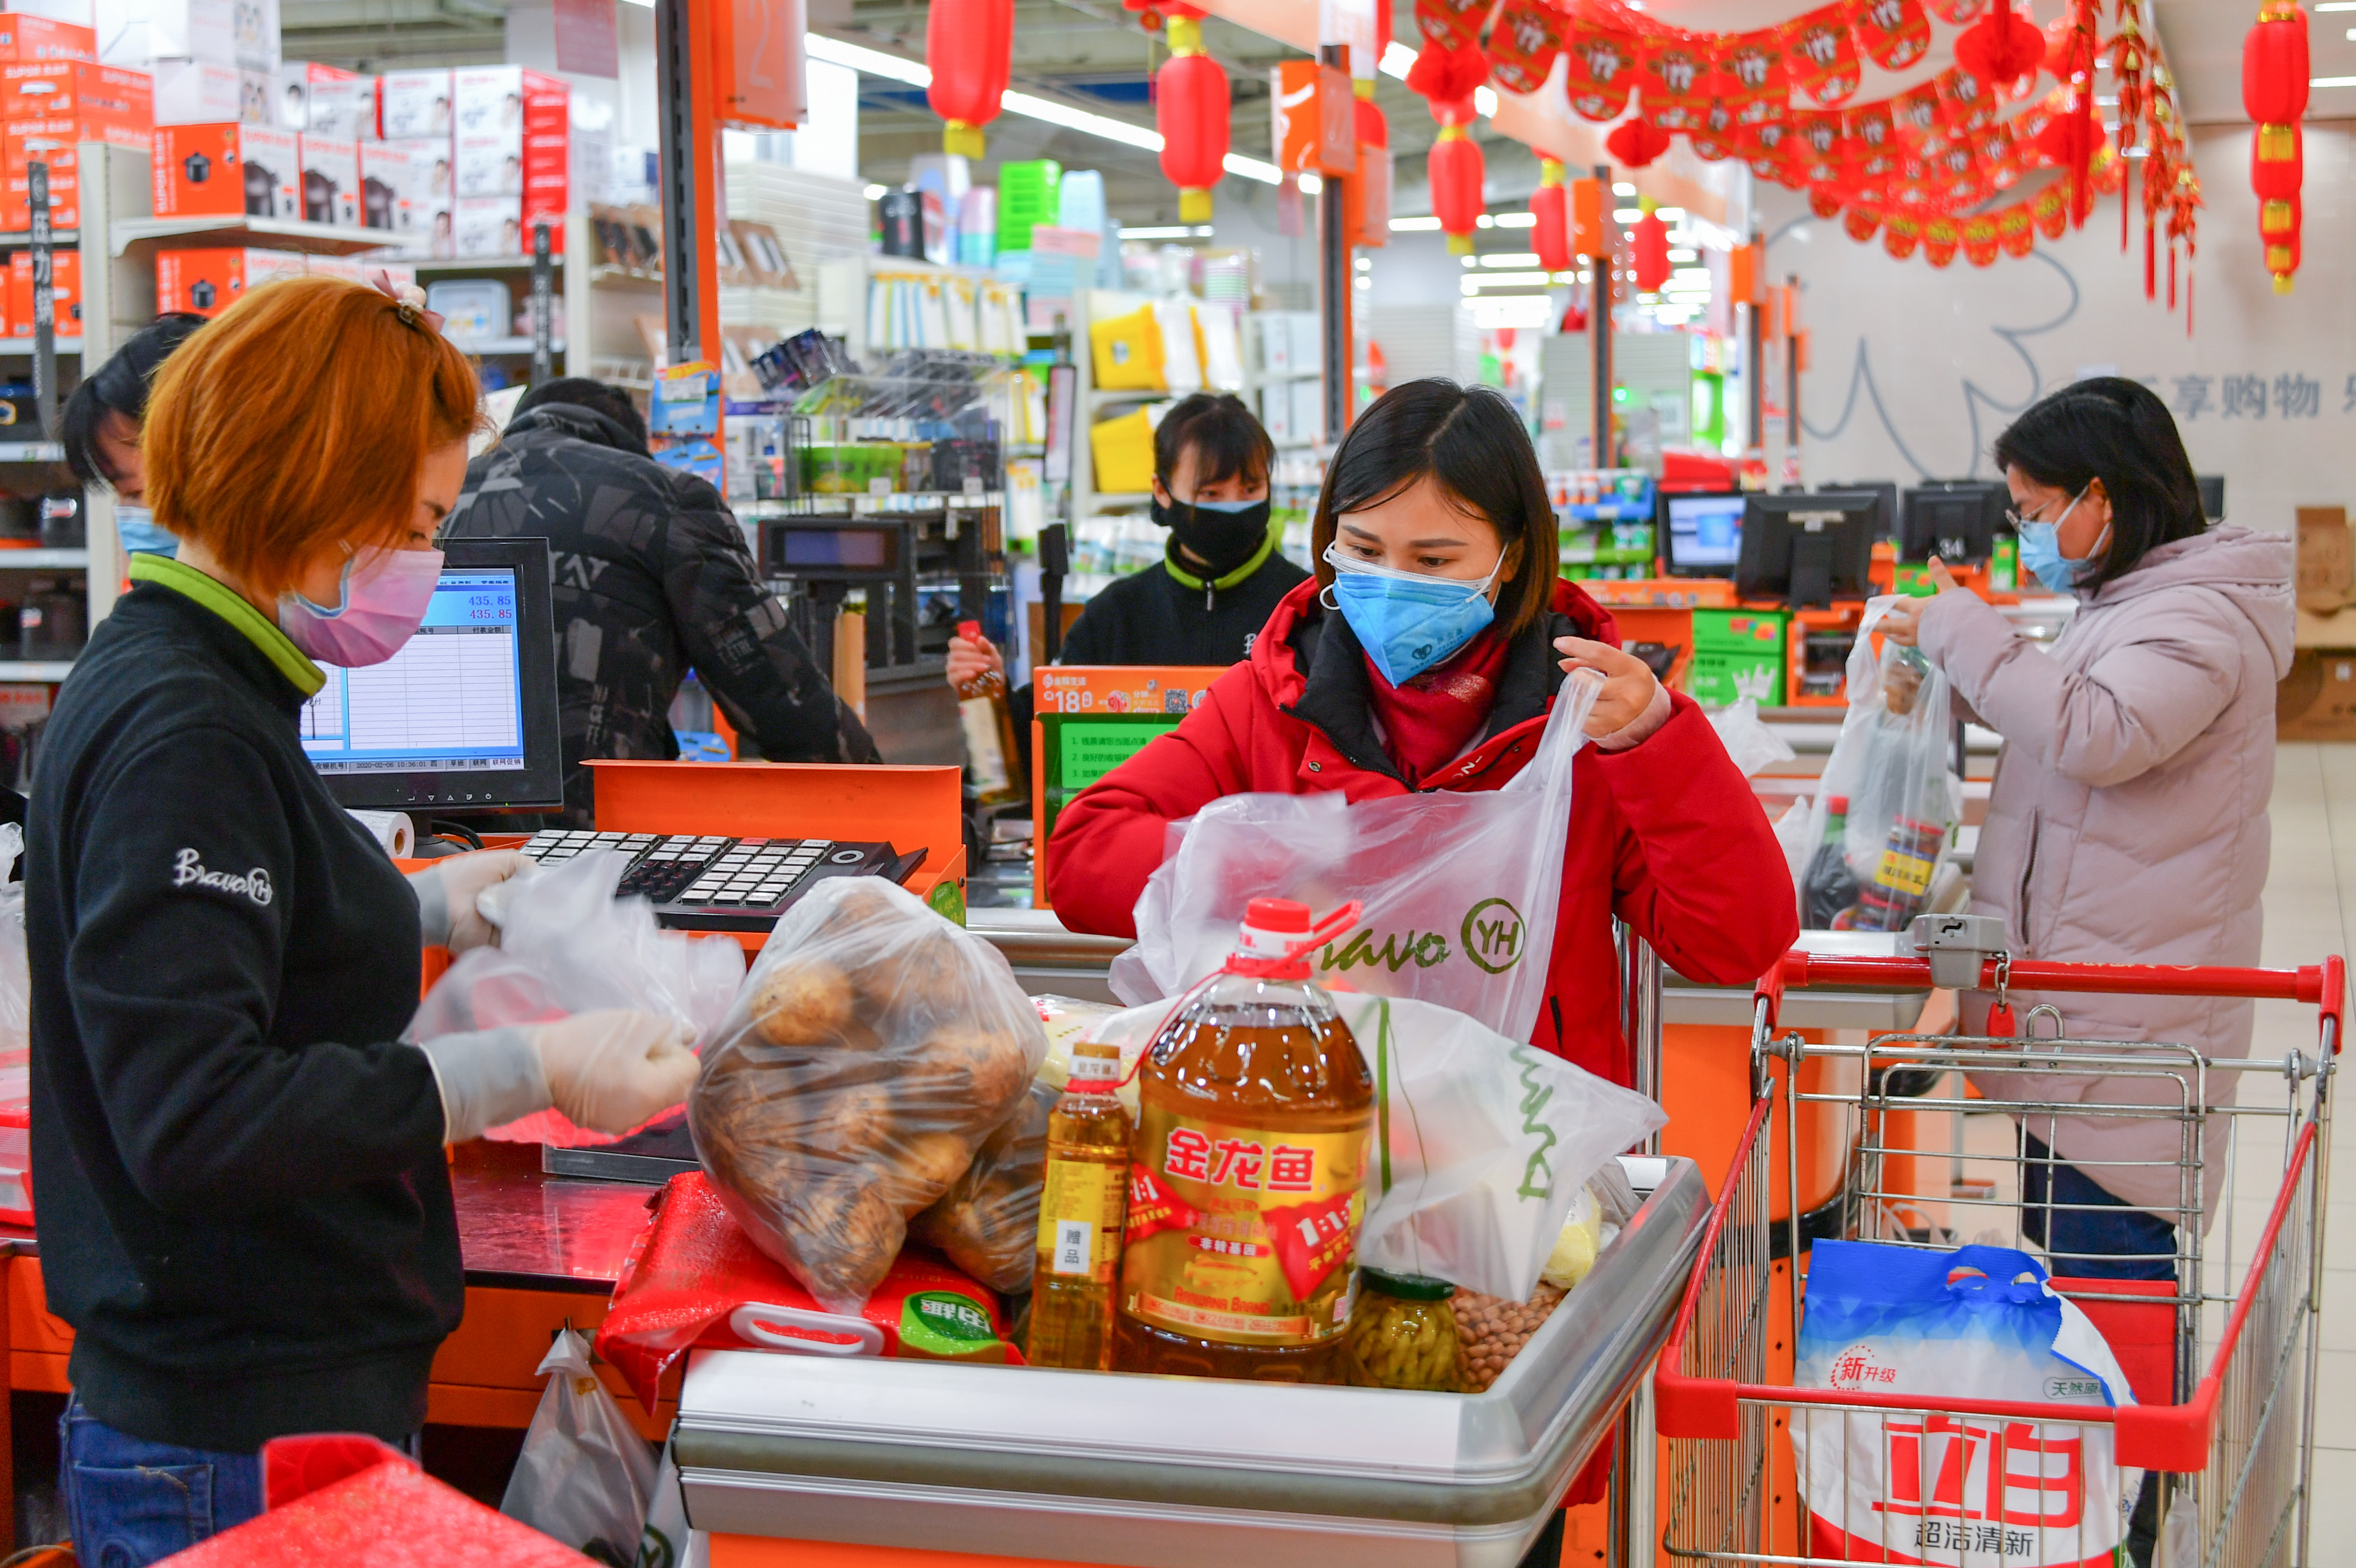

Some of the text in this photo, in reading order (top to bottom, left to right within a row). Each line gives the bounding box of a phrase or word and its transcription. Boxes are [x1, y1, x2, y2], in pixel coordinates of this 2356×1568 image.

[469, 596, 511, 606] 435.85
[470, 609, 512, 619] 435.85
[1056, 691, 1080, 713] 18
[173, 847, 248, 893] Bravo
[1164, 1127, 1315, 1193] 金龙鱼
[1064, 1230, 1081, 1264] 赠品
[1200, 1237, 1257, 1256] 非转基因
[1231, 1296, 1270, 1315] BRAND
[1871, 1414, 2085, 1528] 立白
[1914, 1522, 2034, 1557] 超洁清新
